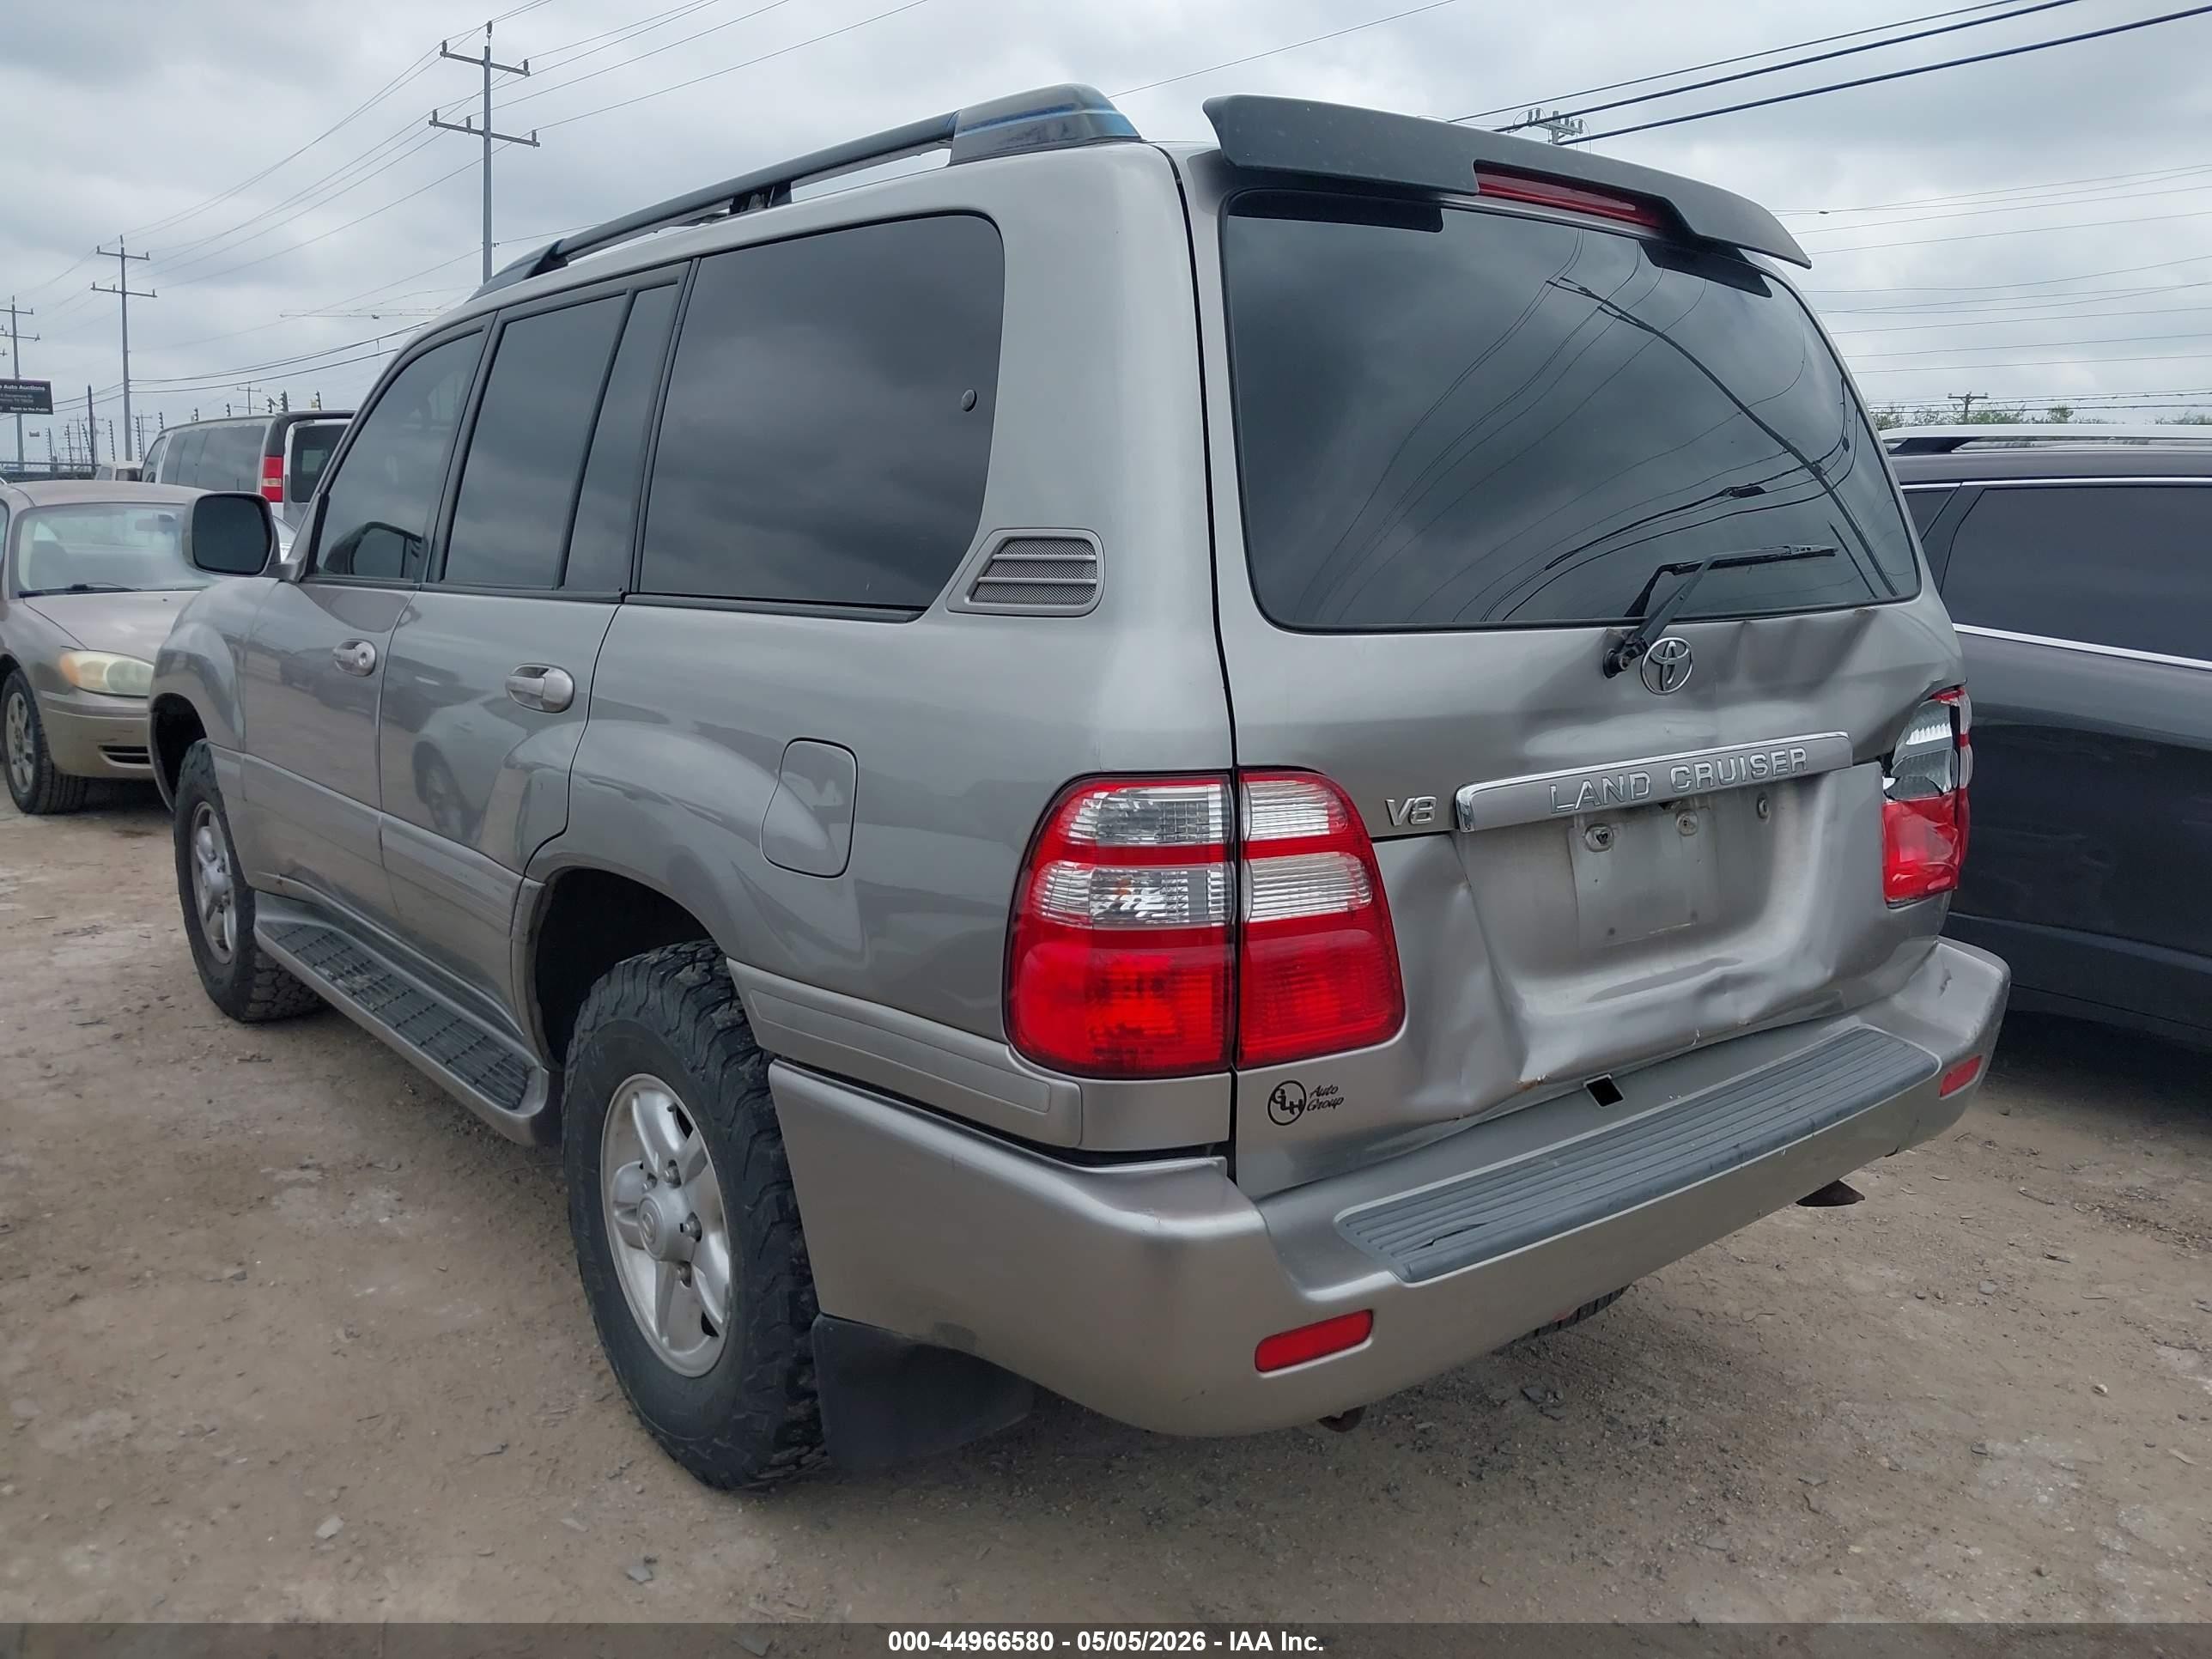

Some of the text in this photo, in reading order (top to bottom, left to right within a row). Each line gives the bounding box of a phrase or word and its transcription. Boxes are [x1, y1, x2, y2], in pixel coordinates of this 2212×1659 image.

[1549, 745, 1809, 815] LAND CRUISER
[1385, 794, 1437, 827] V8
[1310, 1084, 1340, 1099] Auto
[1307, 1097, 1345, 1112] Group
